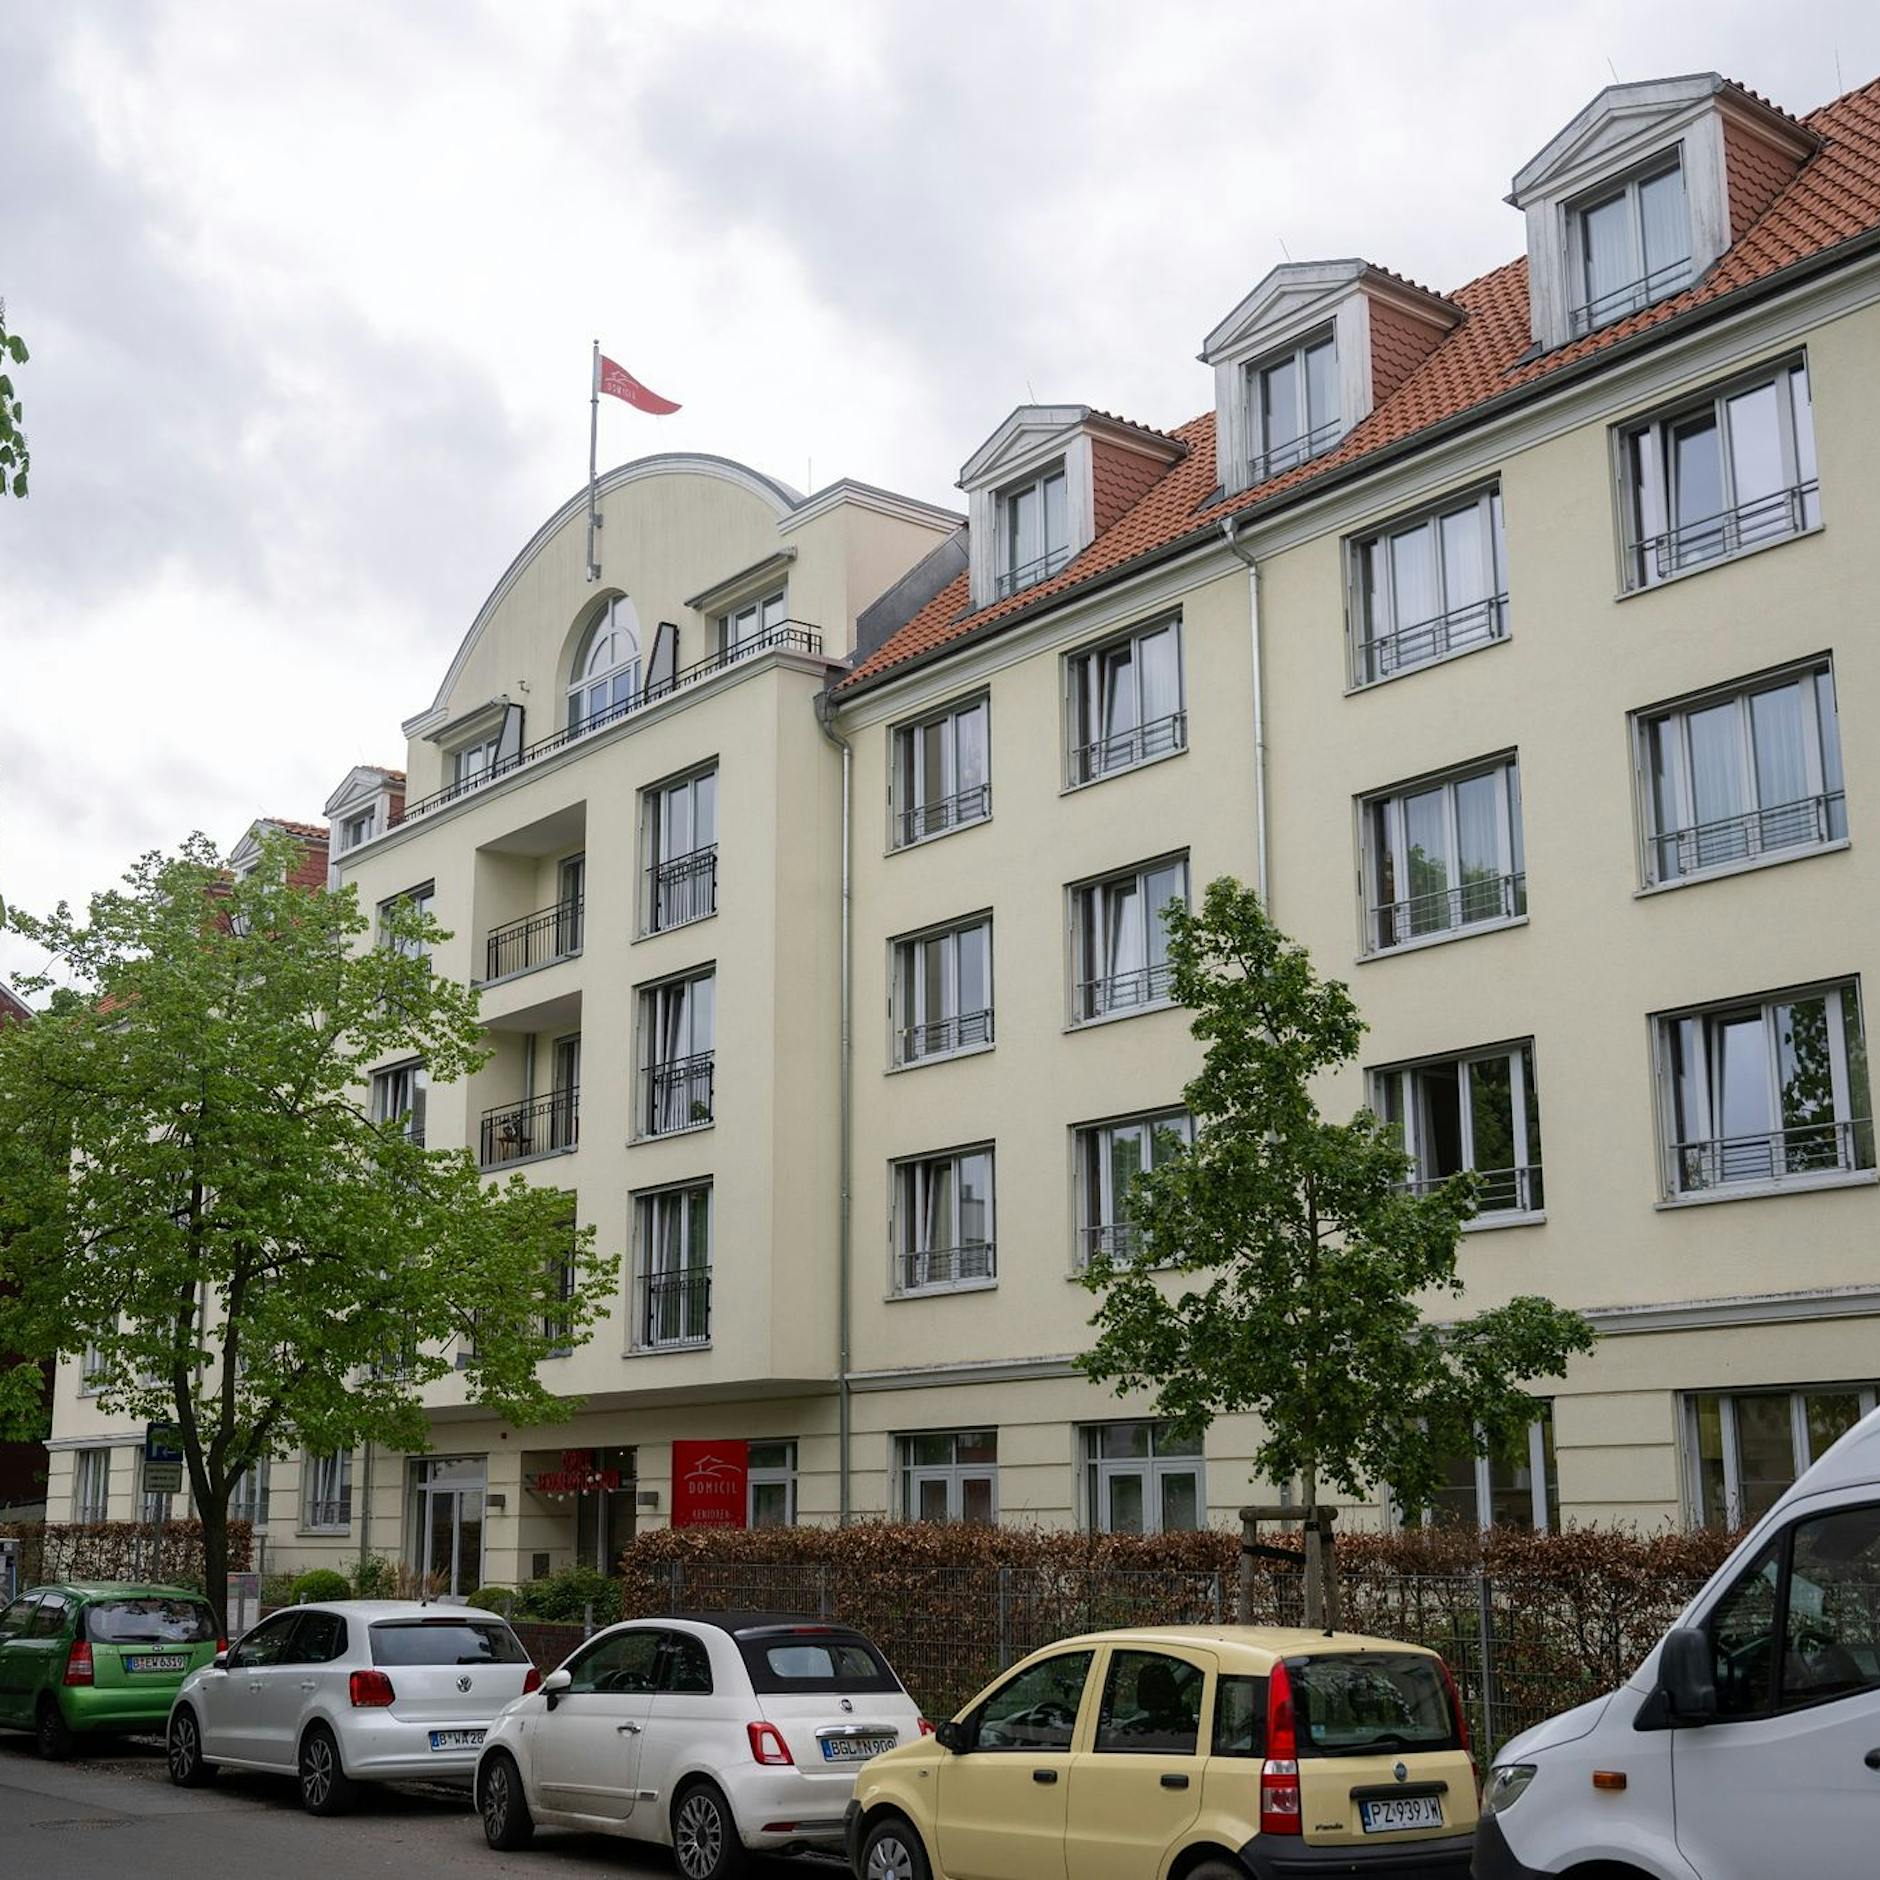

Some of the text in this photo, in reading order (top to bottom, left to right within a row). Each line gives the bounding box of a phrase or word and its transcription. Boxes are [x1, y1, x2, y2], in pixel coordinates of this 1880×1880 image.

[689, 1480, 738, 1495] DOMICIL
[439, 1733, 447, 1746] B
[470, 1732, 486, 1744] 28
[831, 1741, 856, 1755] BGL
[863, 1740, 873, 1754] N
[1370, 1802, 1394, 1825] PZ
